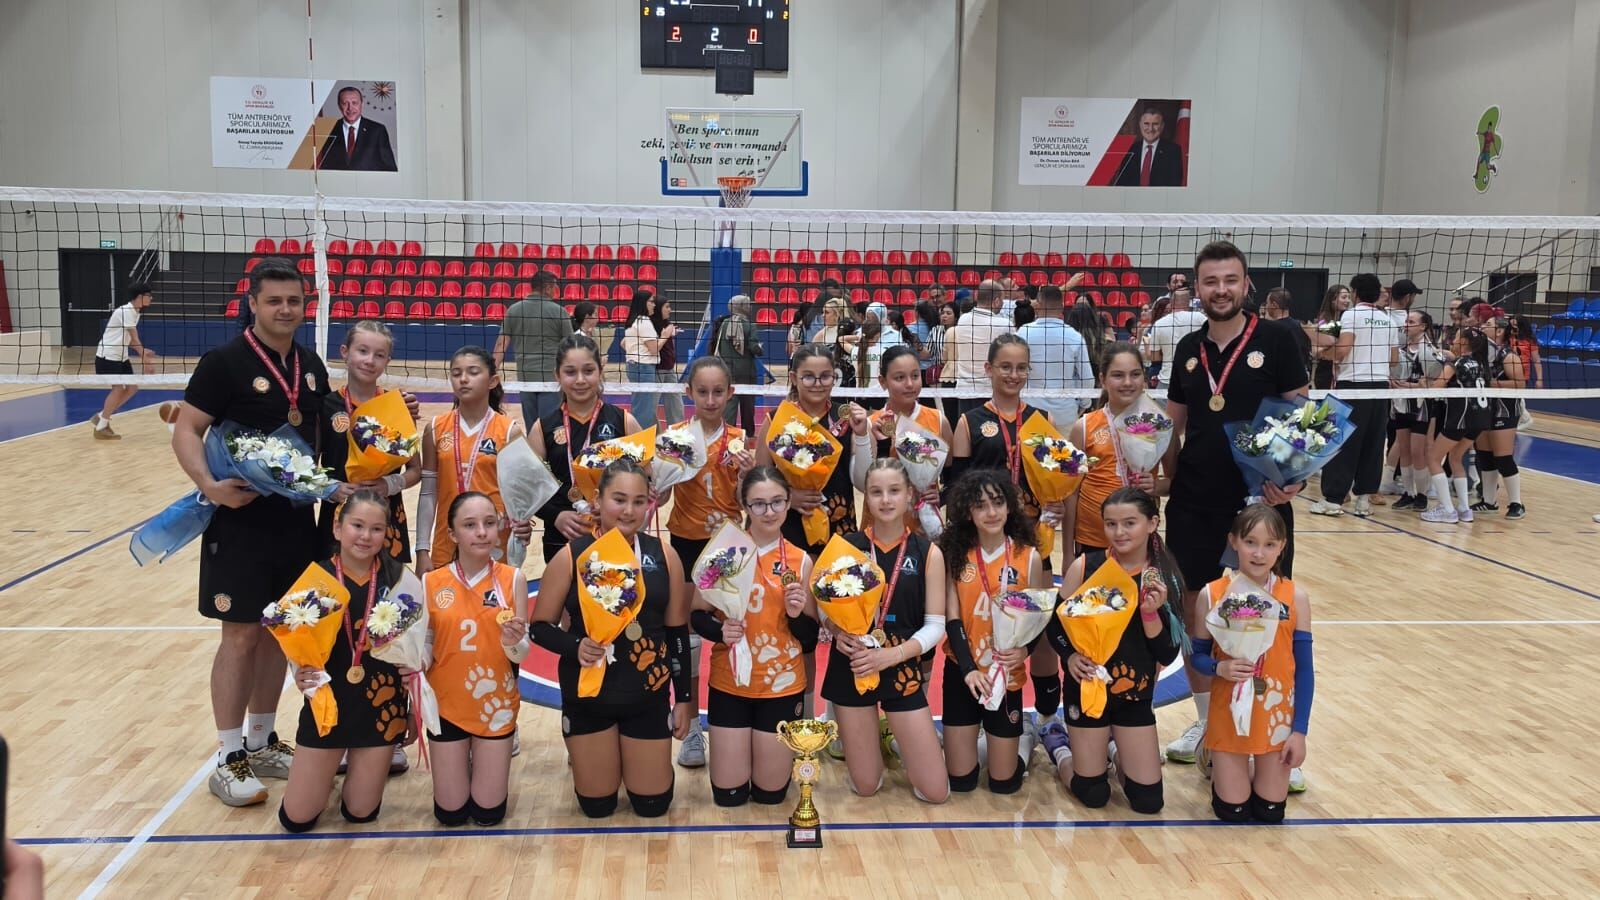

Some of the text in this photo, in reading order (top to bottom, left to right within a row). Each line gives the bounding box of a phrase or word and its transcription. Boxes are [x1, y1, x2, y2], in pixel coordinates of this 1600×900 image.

[672, 26, 680, 40] 2
[711, 27, 719, 41] 2
[750, 29, 757, 42] 0
[230, 120, 290, 128] SPORCULARIMIZA
[245, 113, 282, 121] ANTRENÖR
[640, 138, 665, 149] zeki,
[700, 141, 711, 149] ve
[702, 472, 713, 499] 1
[748, 583, 765, 614] 3
[973, 591, 991, 621] 4
[460, 618, 477, 652] 2
